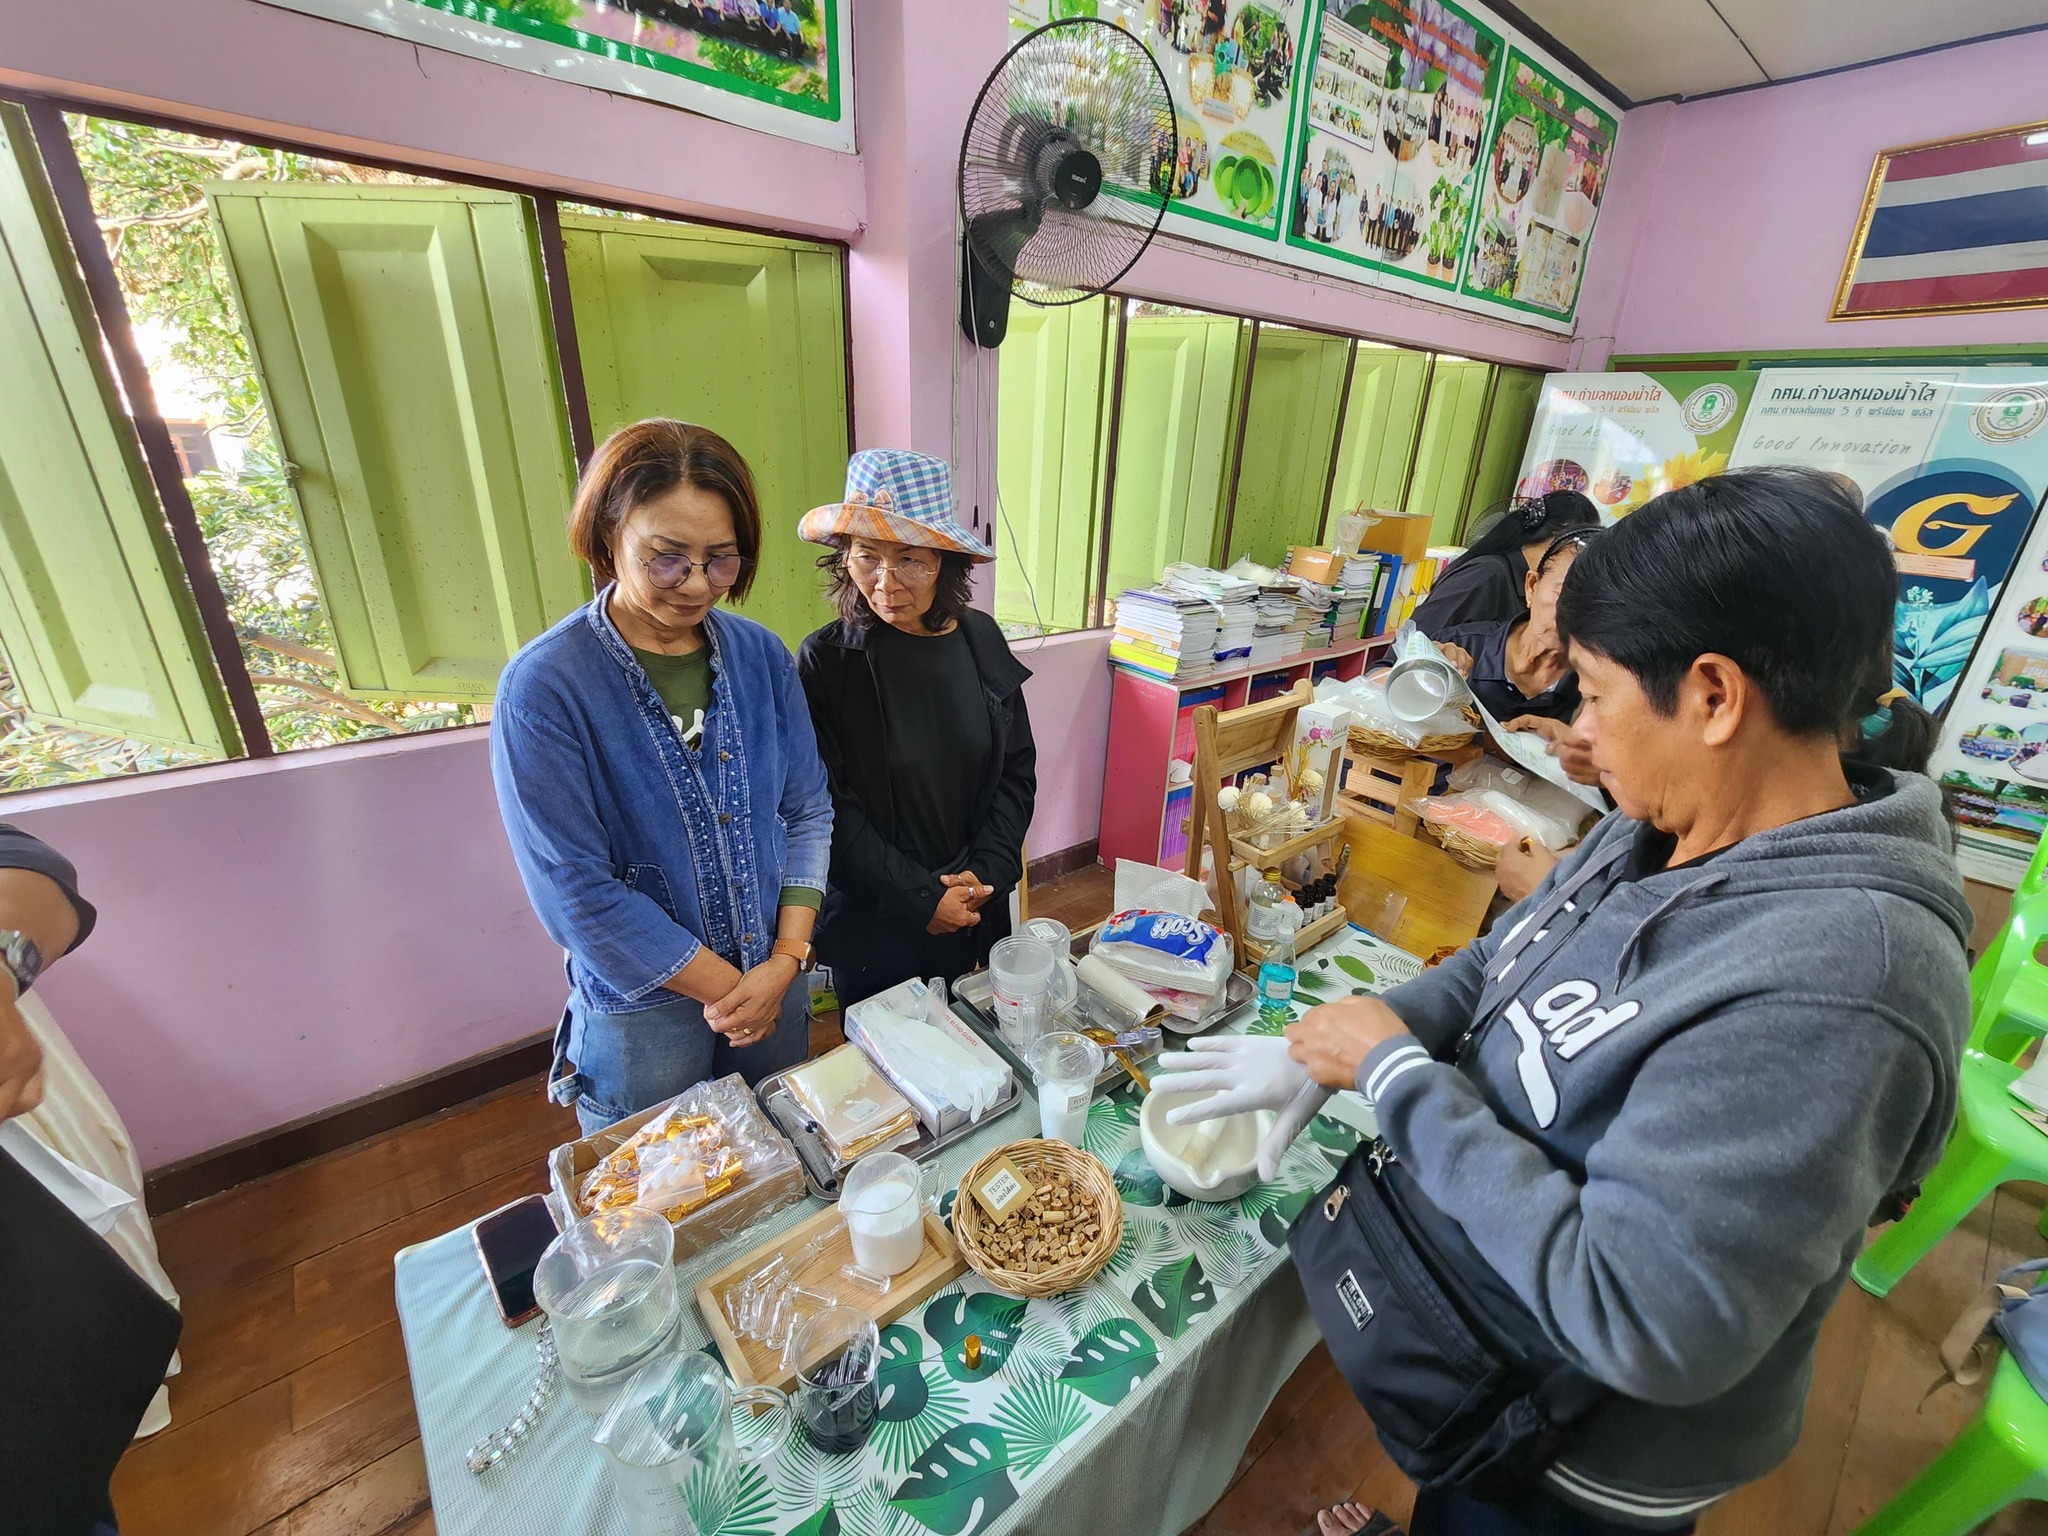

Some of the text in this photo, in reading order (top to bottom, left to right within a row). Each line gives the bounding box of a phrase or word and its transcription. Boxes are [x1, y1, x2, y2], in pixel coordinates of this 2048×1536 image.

[1770, 381, 1938, 402] กศน.ตำบลหนองน้ำใส
[1840, 406, 1850, 416] 5
[1752, 435, 1913, 455] Good Innovation
[1150, 916, 1213, 945] Scott
[987, 1174, 1011, 1196] TESTER
